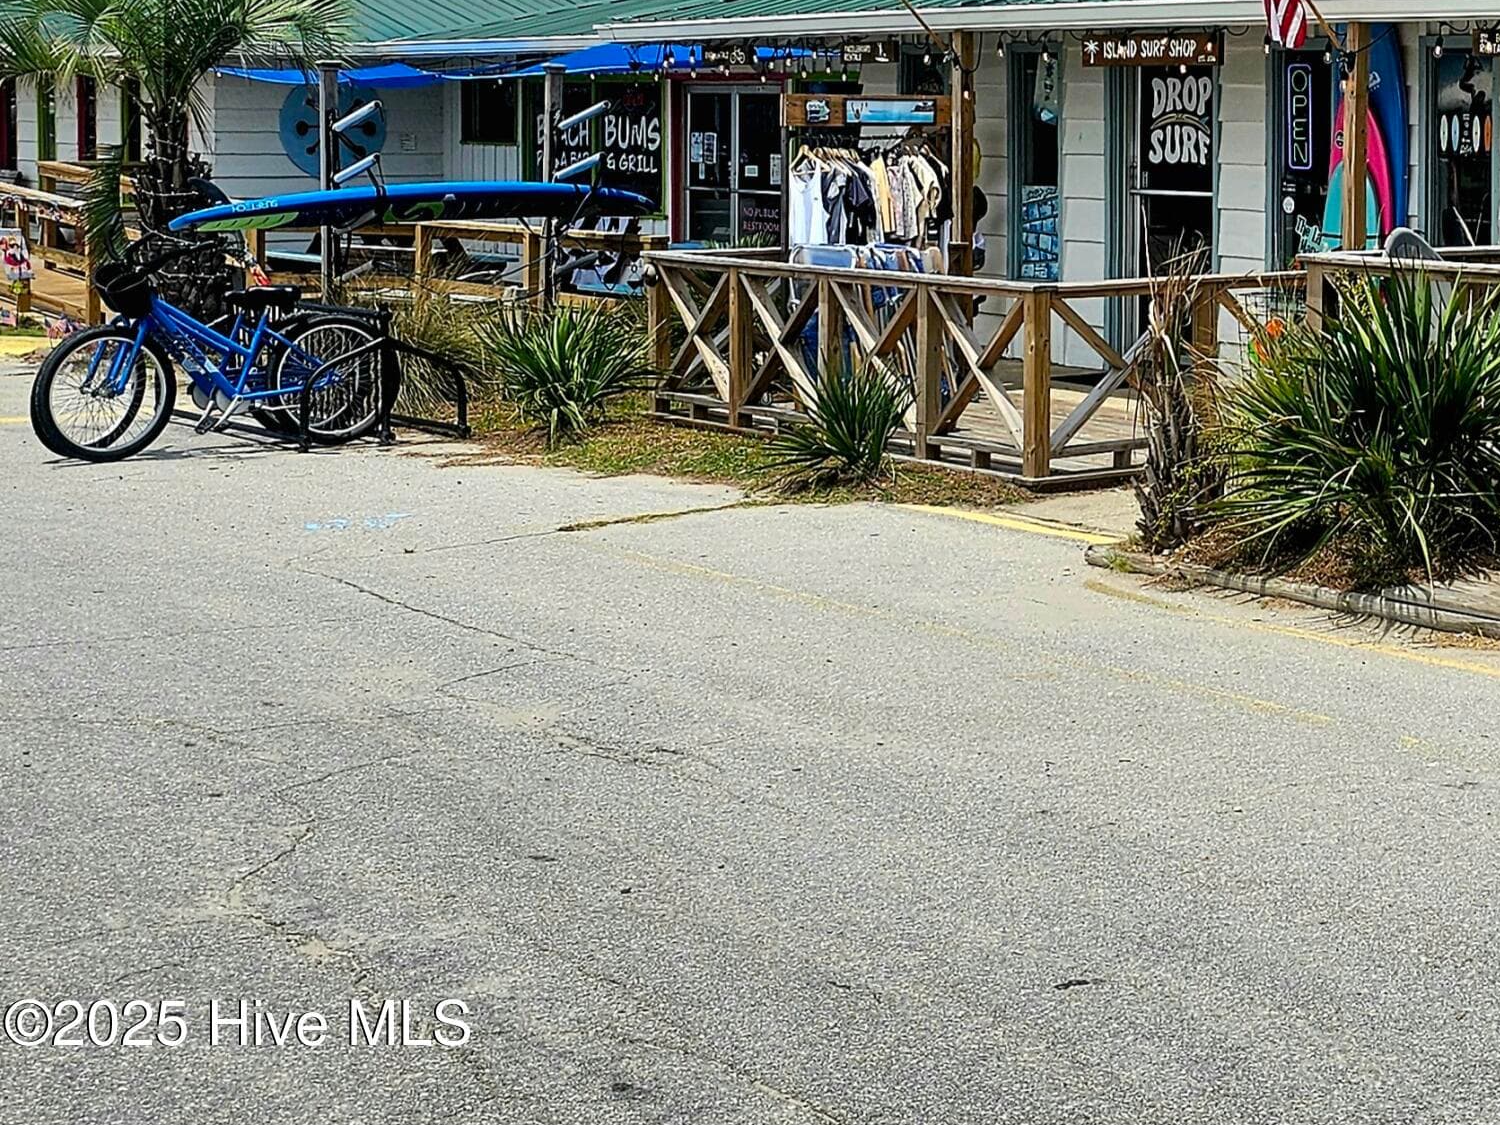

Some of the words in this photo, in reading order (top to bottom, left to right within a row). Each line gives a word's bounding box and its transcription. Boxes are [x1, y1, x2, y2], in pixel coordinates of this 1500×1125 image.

[1103, 40, 1137, 59] ISLAND
[1140, 39, 1167, 58] SURF
[1168, 38, 1197, 58] SHOP
[1151, 75, 1213, 118] DROP
[536, 113, 589, 147] BACH
[604, 114, 660, 151] BUMS
[1291, 69, 1308, 164] OPEN
[606, 152, 616, 171] &
[618, 152, 658, 174] GRILL
[1148, 125, 1211, 165] SURF
